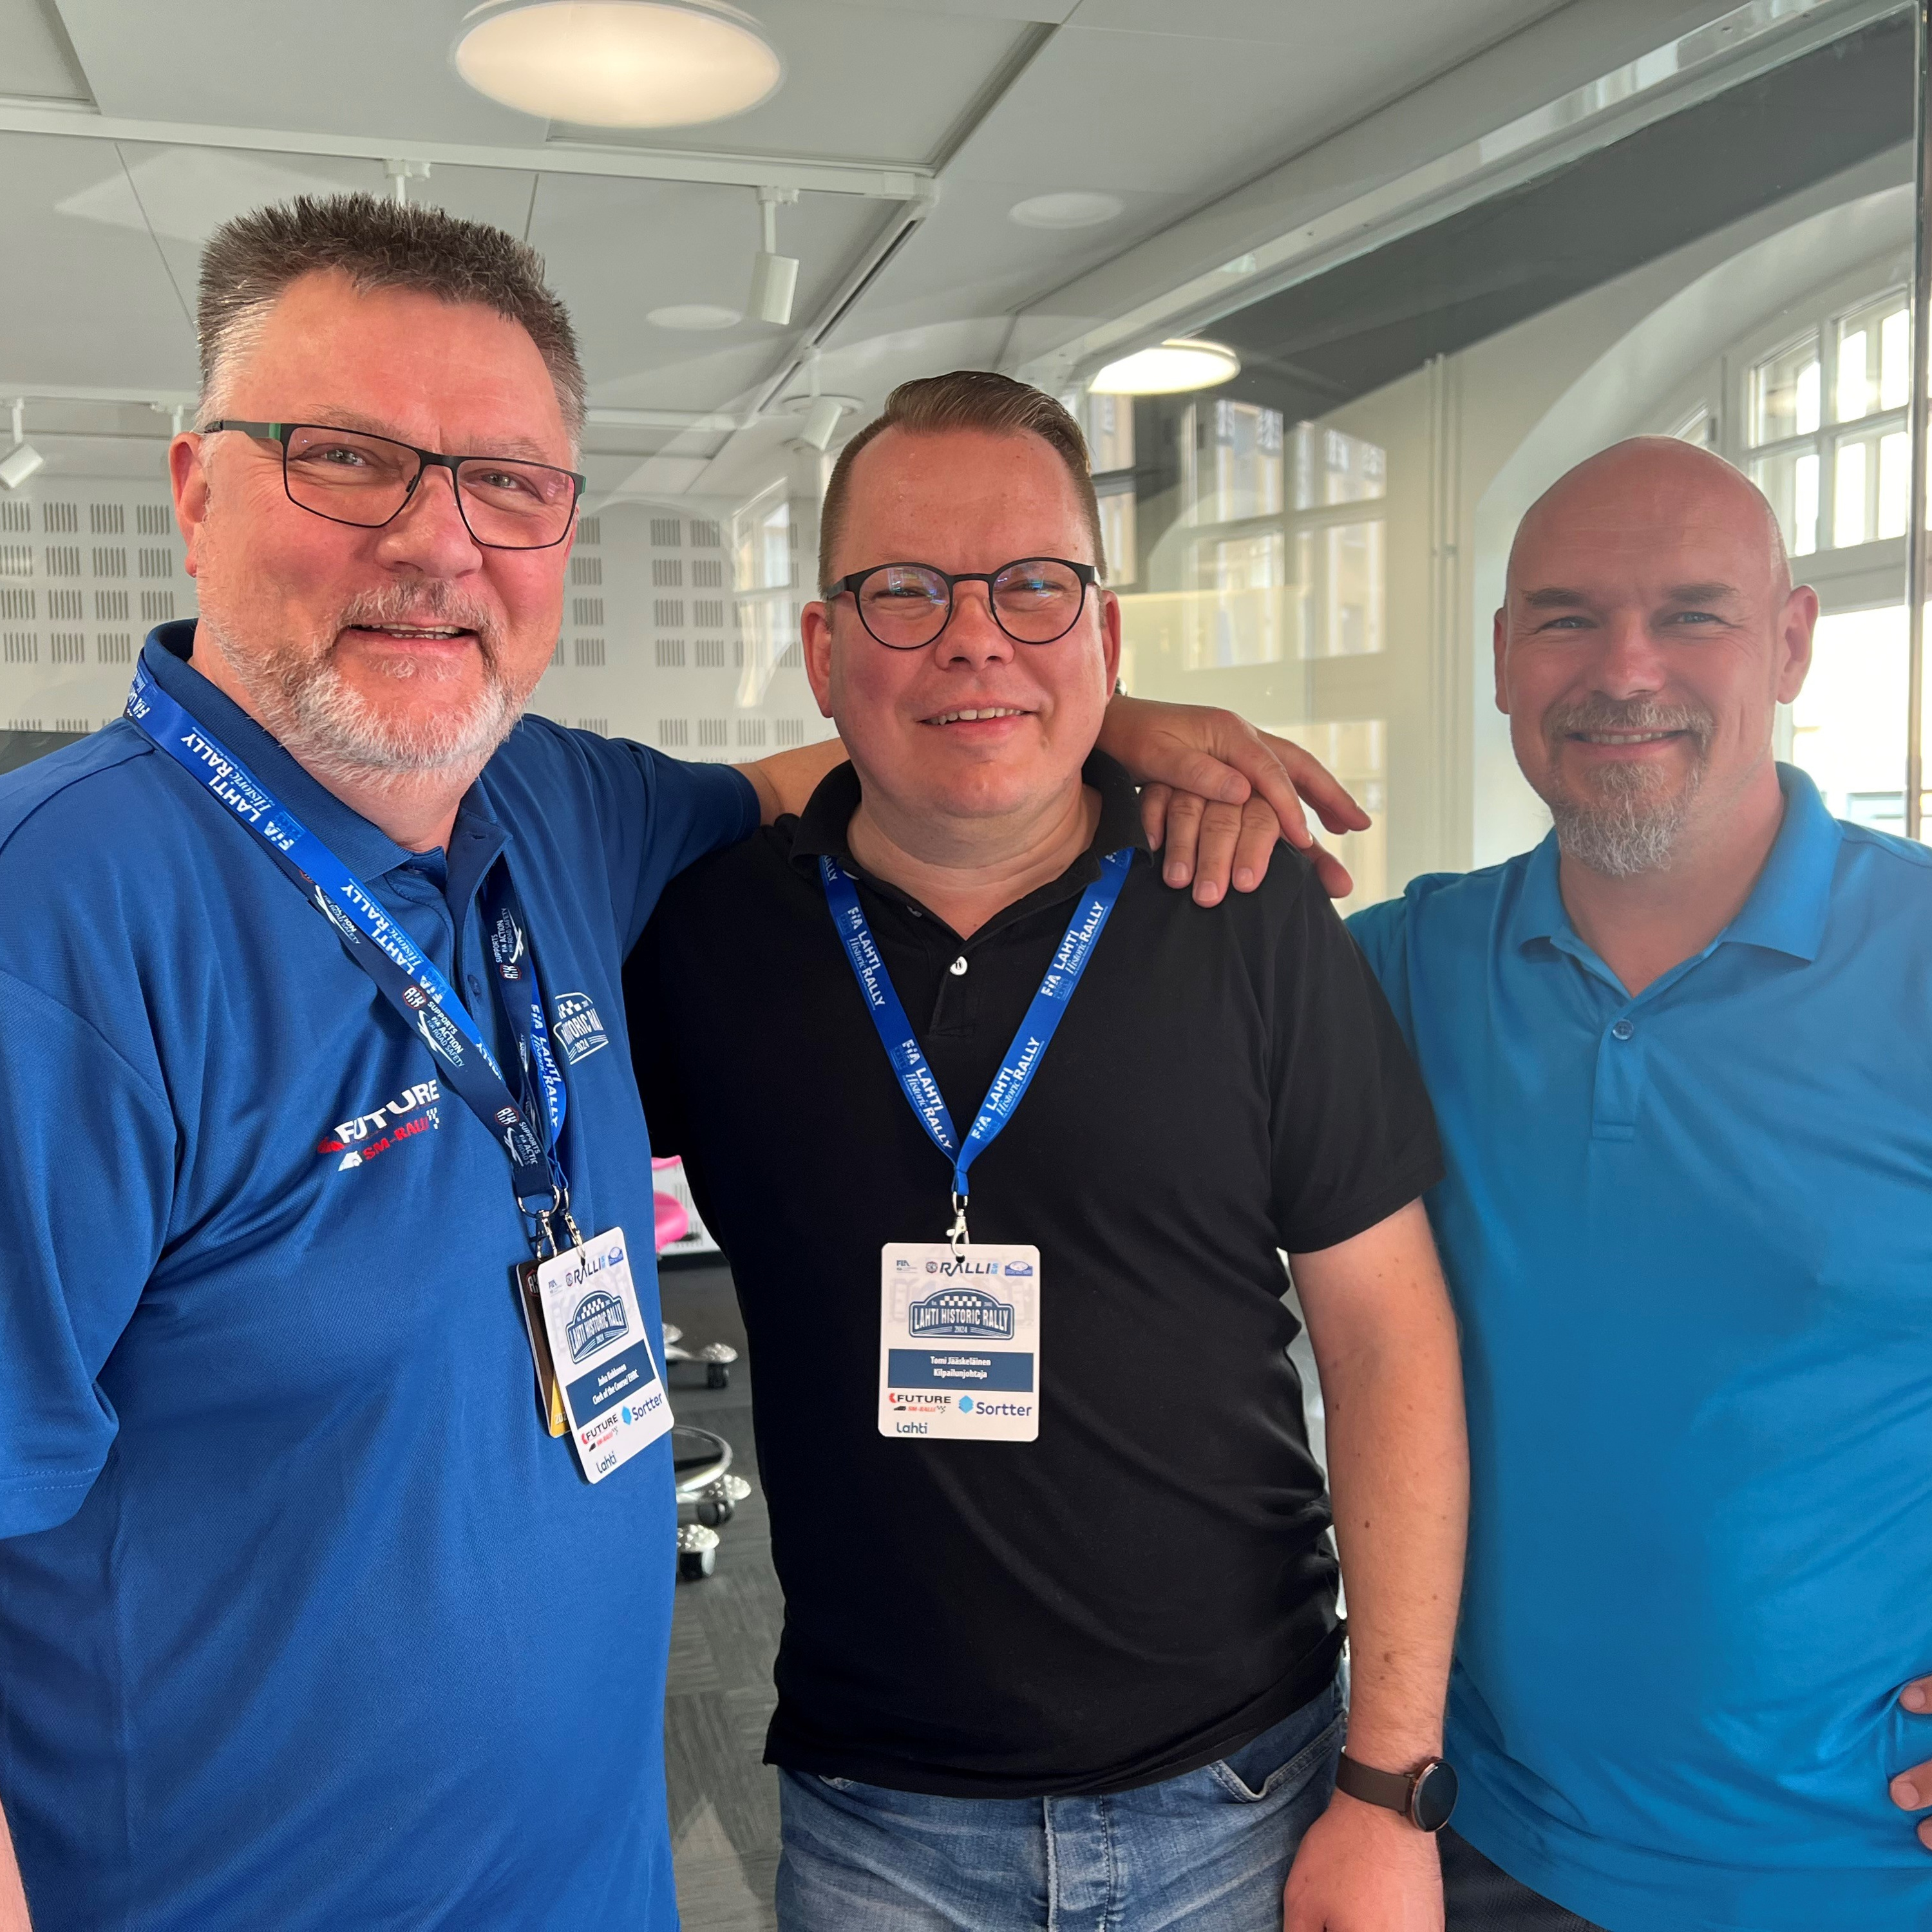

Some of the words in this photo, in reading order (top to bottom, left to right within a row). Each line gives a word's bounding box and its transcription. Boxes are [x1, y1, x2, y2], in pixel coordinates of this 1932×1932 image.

[180, 733, 234, 777] RALLY
[209, 775, 261, 822] LAHTI
[229, 772, 272, 811] Historic
[340, 884, 389, 928] RALLY
[501, 908, 511, 929] SAFETY
[341, 922, 361, 944] SAFETY
[386, 927, 421, 966] Historic
[491, 934, 502, 963] SUPPORTS
[497, 920, 507, 943] ACTION
[857, 930, 881, 971] LAHTI
[1053, 930, 1079, 971] LAHTI
[1065, 941, 1087, 975] Historic
[1079, 901, 1104, 943] RALLY
[371, 929, 415, 976] LAHTI
[849, 937, 867, 969] Historic
[862, 967, 886, 1006] RALLY
[427, 1001, 458, 1034] SUPPORTS
[432, 1028, 448, 1046] ROAD
[445, 1045, 465, 1067] SAFETY
[438, 1027, 464, 1054] ACTION
[539, 1036, 562, 1083] LAHTI
[574, 1038, 590, 1053] 2024
[915, 1066, 943, 1111] LAHTI
[985, 1067, 1014, 1111] LAHTI
[996, 1079, 1021, 1116] Historic
[1012, 1036, 1040, 1081] RALLY
[334, 1079, 440, 1144] FUTURE
[543, 1075, 558, 1128] RALLY
[905, 1074, 928, 1108] Historic
[922, 1106, 952, 1149] RALLY
[518, 1121, 541, 1154] SUPPORTS
[940, 1262, 990, 1276] RALLI
[569, 1323, 587, 1355] LAHTI
[583, 1311, 609, 1339] HISTORIC
[606, 1303, 625, 1327] RALLY
[914, 1308, 939, 1330] LAHTI
[941, 1308, 981, 1325] HISTORIC
[982, 1309, 1009, 1332] RALLY
[930, 1356, 947, 1364] Tomi
[947, 1356, 991, 1365] Jääskeläinen
[933, 1368, 988, 1379] Kilpailunjohtaja
[603, 1388, 609, 1398] of
[607, 1386, 616, 1396] the
[632, 1393, 663, 1421] Sortter
[897, 1394, 951, 1404] FUTURE
[976, 1402, 1032, 1416] Sortter
[585, 1414, 618, 1441] FUTURE
